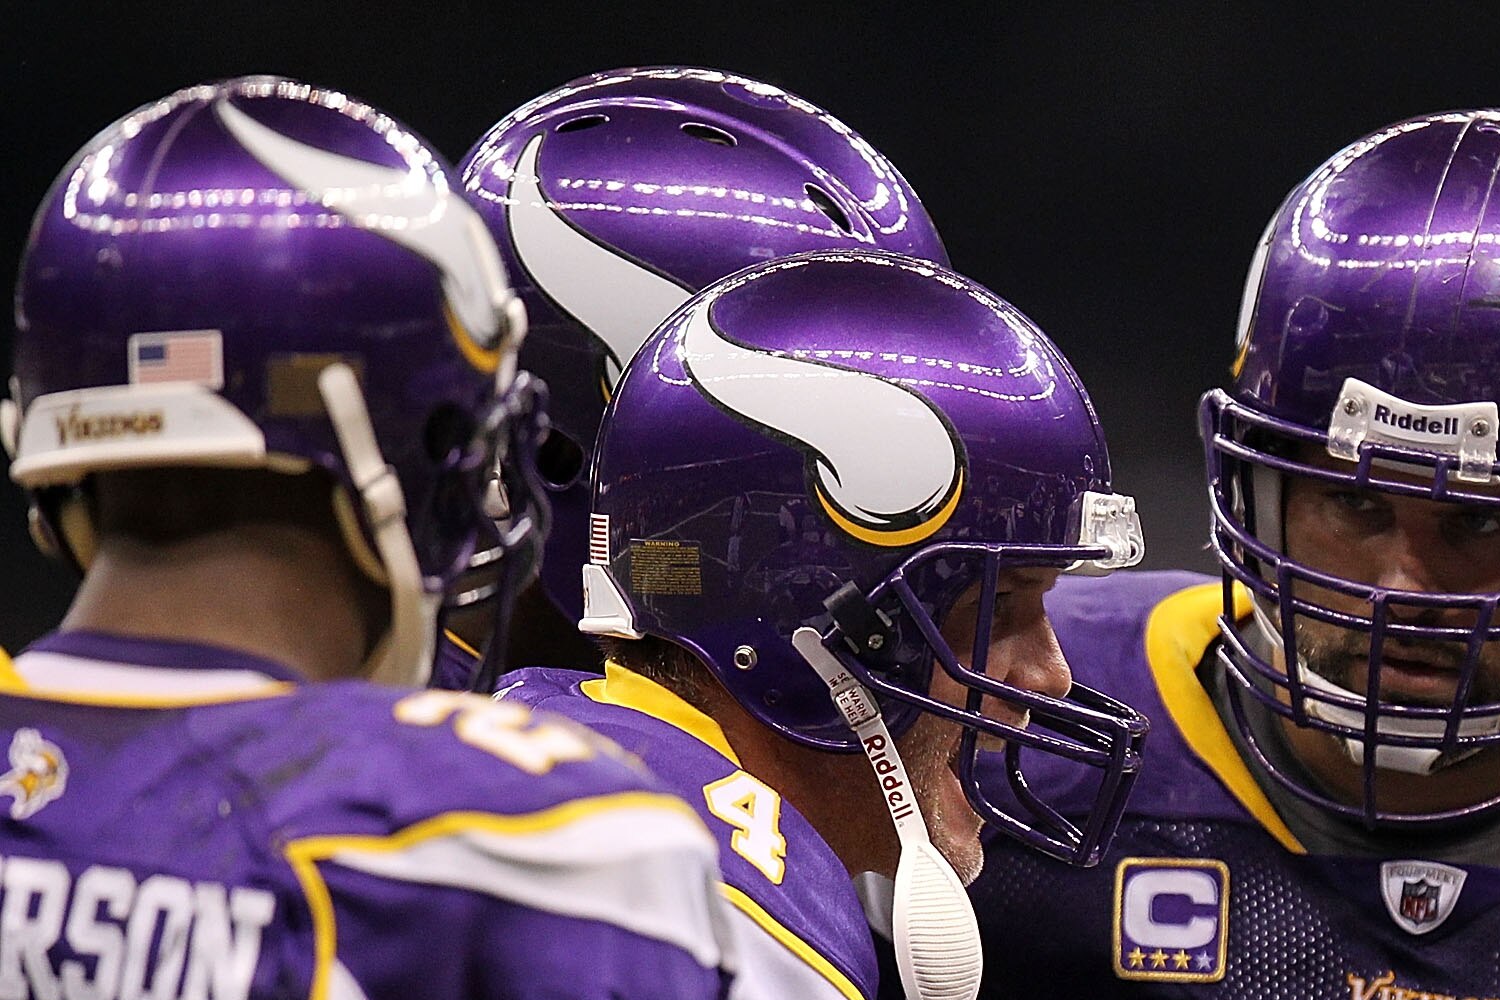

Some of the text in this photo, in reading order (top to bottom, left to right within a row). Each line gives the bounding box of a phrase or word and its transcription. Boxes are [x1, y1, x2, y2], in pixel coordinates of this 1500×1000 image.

[1374, 403, 1459, 435] Riddell
[862, 734, 914, 821] Riddell
[703, 768, 787, 886] 4
[1123, 868, 1218, 950] C
